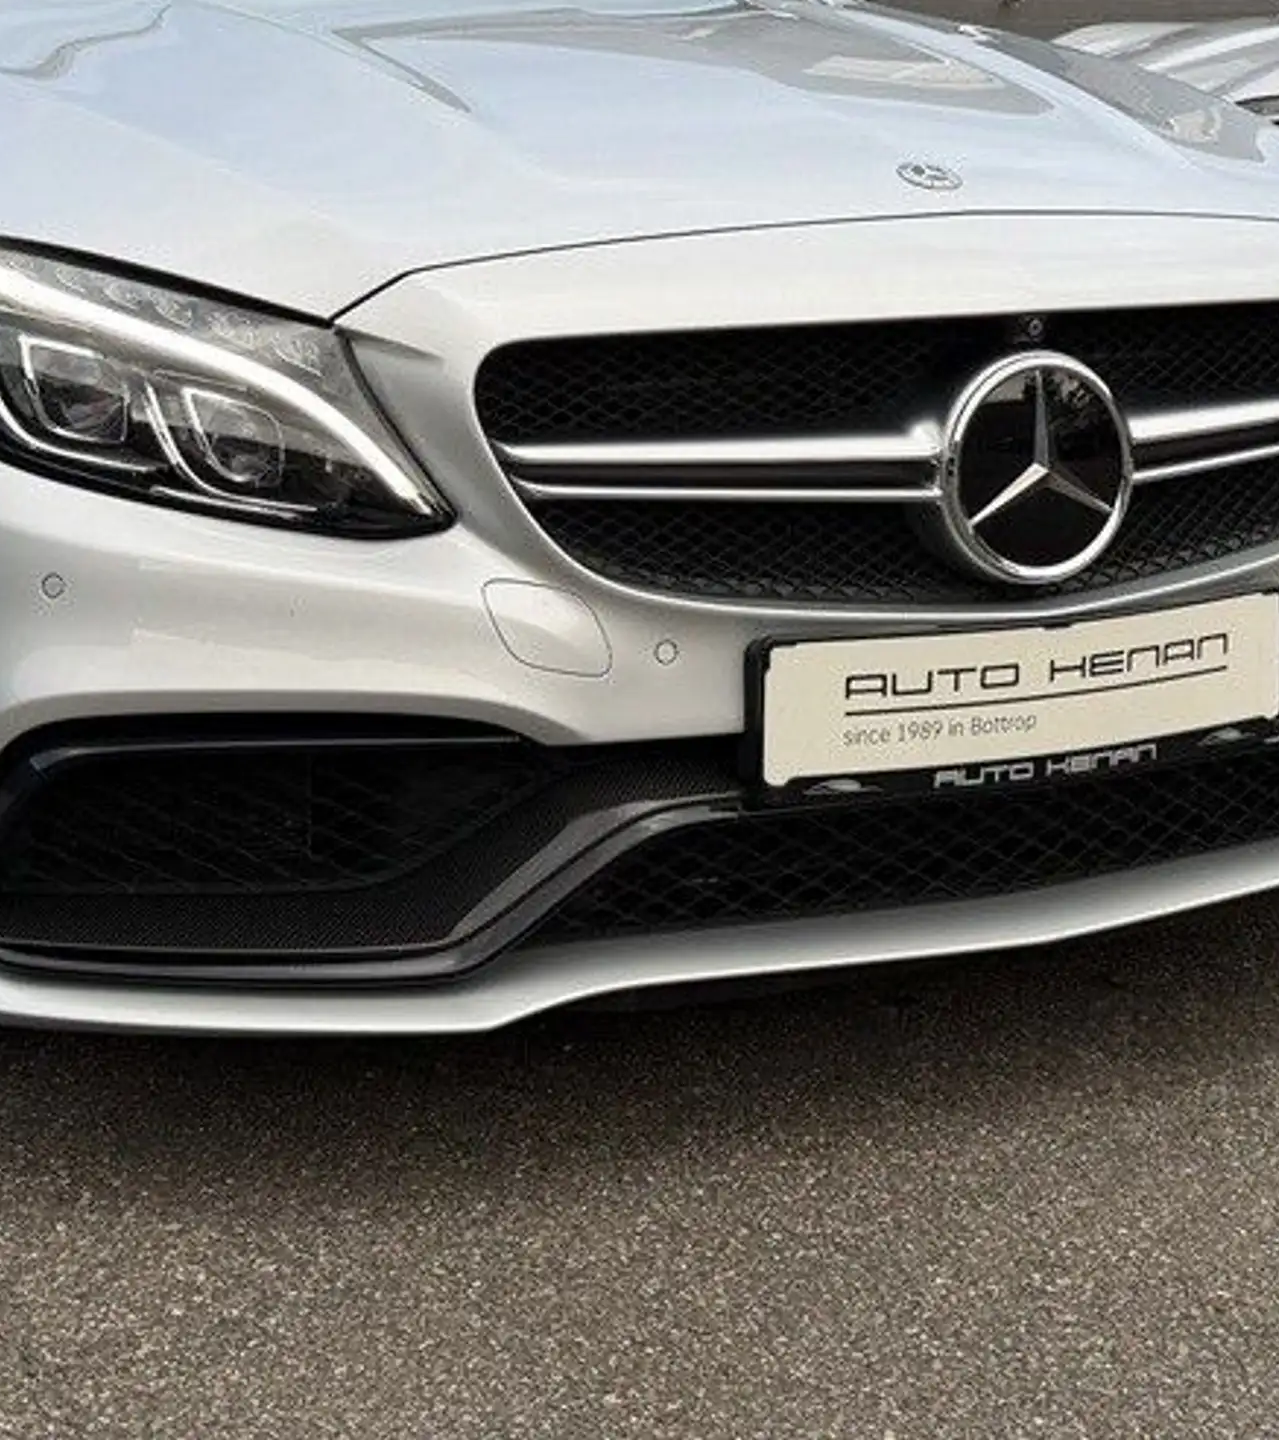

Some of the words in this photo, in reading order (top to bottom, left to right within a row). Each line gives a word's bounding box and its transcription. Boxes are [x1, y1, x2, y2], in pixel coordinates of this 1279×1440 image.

[844, 662, 1020, 700] AUTO
[1048, 632, 1228, 682] KENAN
[842, 724, 892, 748] since
[896, 720, 943, 743] 1989
[947, 718, 965, 738] in
[970, 714, 1038, 736] Bottrop
[933, 761, 1035, 789] AUTO
[1045, 743, 1158, 777] KENAN
